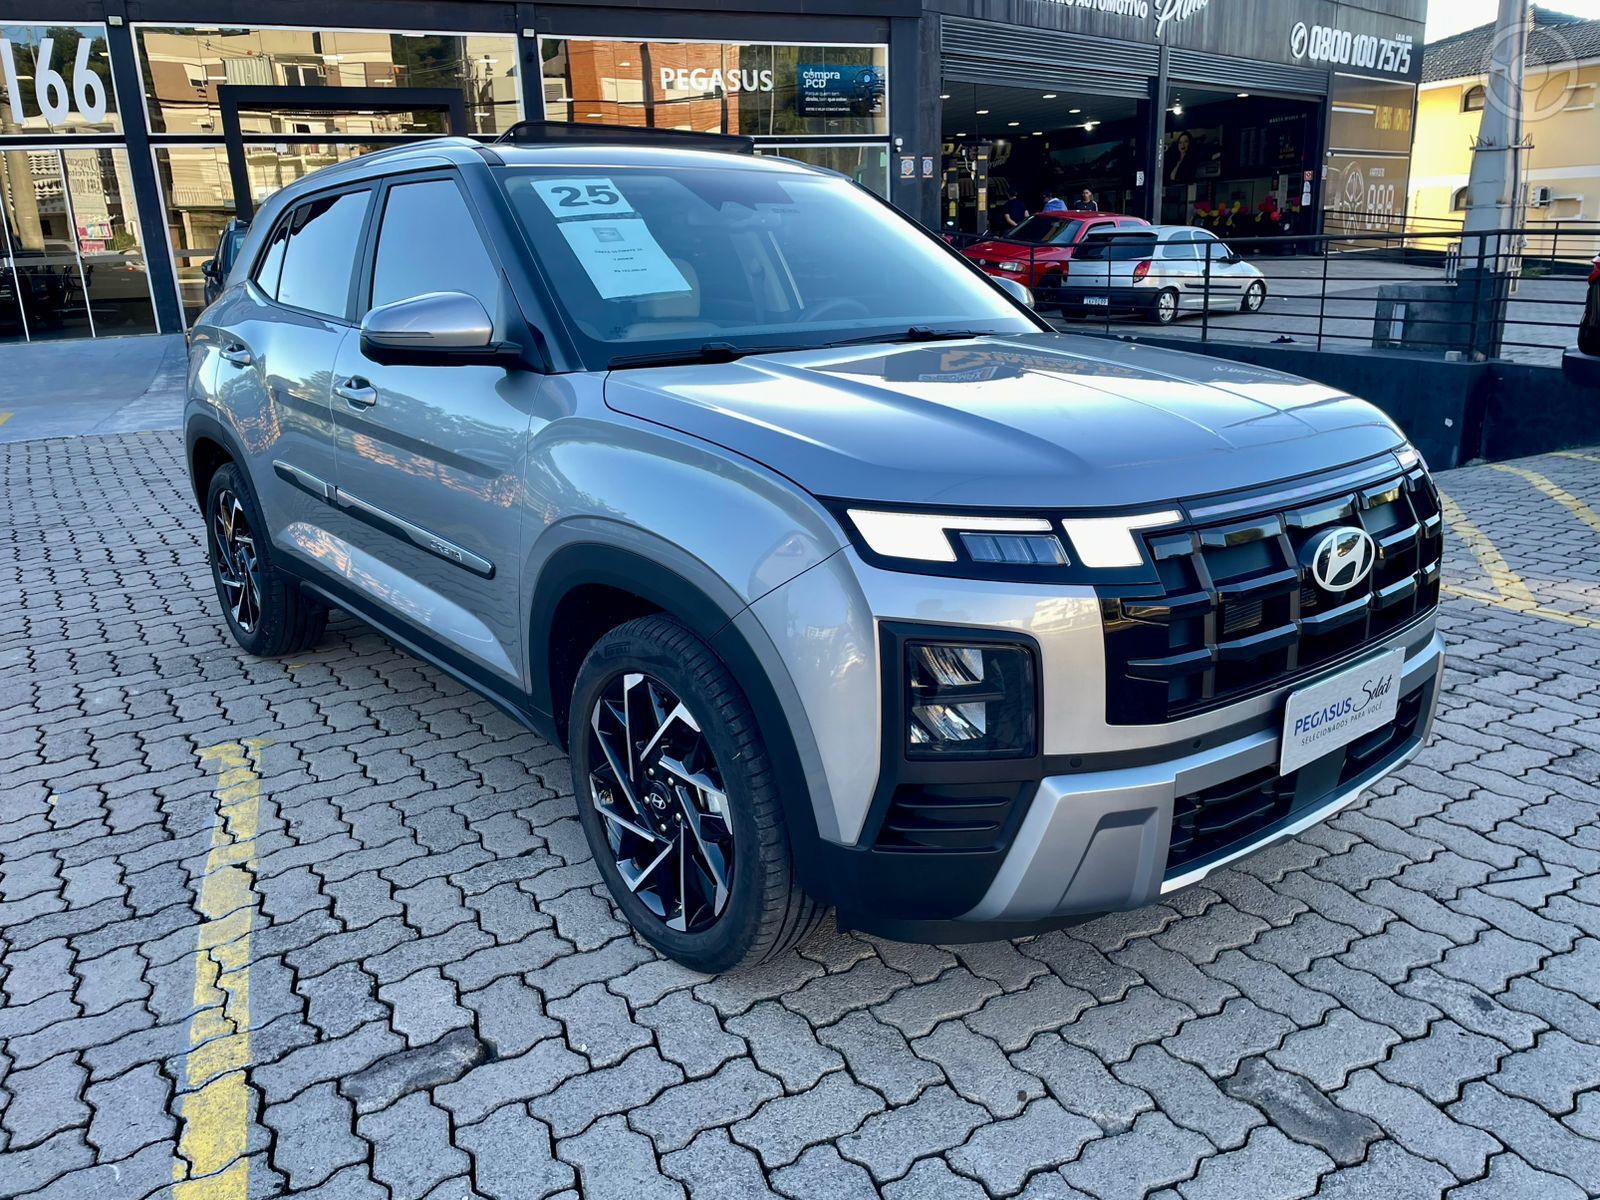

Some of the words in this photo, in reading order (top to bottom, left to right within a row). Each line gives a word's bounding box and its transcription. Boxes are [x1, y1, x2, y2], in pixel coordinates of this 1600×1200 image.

[1308, 25, 1352, 64] 0800
[1351, 34, 1378, 68] 100
[1377, 38, 1413, 74] 7575
[660, 67, 774, 92] PEGASUS
[550, 185, 619, 207] 25
[1294, 697, 1352, 736] PEGASUS
[1352, 674, 1392, 712] Select
[1301, 718, 1349, 746] SELECIONADOS
[1350, 710, 1366, 723] PARA
